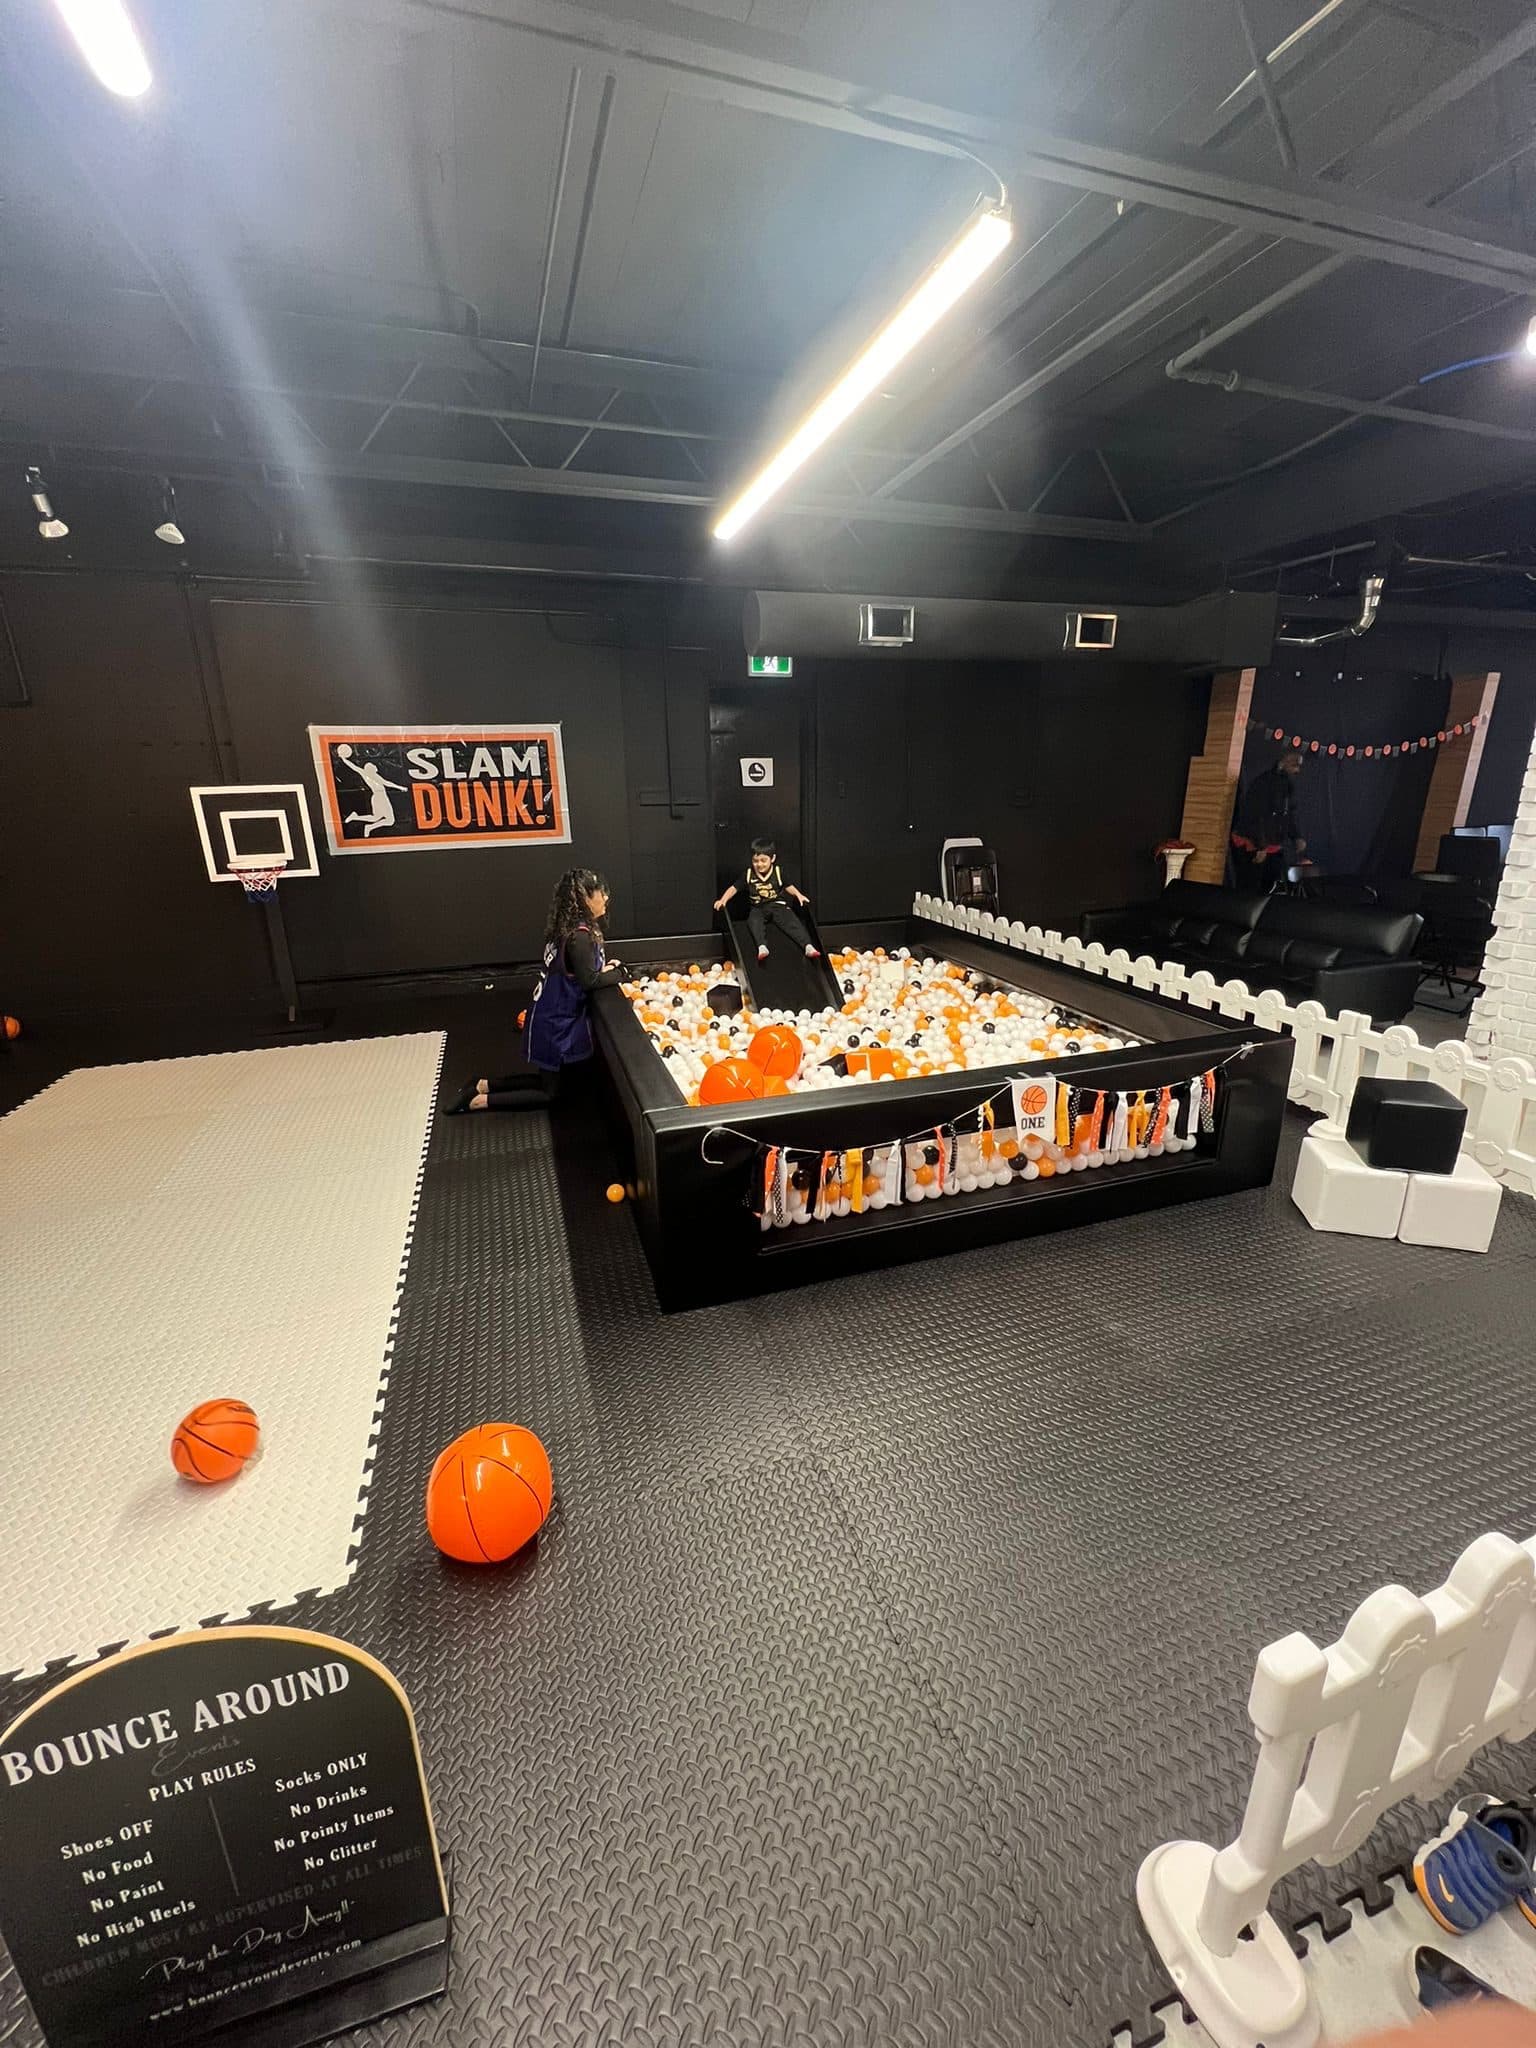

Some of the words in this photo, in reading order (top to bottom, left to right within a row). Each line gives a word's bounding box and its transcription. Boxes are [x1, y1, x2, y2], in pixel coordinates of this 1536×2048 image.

[406, 746, 542, 780] SLAM
[412, 779, 546, 830] DUNK!
[1021, 1117, 1045, 1130] ONE
[0, 1709, 179, 1786] BOUNCE
[193, 1661, 350, 1733] AROUND
[148, 1780, 195, 1801] PLAY
[201, 1758, 257, 1786] RULES
[275, 1770, 322, 1793] Socks
[327, 1753, 369, 1776] ONLY
[290, 1803, 311, 1818] No
[317, 1785, 367, 1809] Drinks
[60, 1834, 114, 1860] Shoes
[120, 1820, 154, 1842] OFF
[274, 1837, 295, 1853] No
[300, 1820, 348, 1845] Pointy
[354, 1805, 395, 1827] Items
[83, 1869, 106, 1885] No
[112, 1852, 153, 1876] Food
[304, 1856, 324, 1871] No
[330, 1839, 377, 1863] Glitter
[90, 1897, 115, 1913] No
[120, 1880, 165, 1904] Paint
[77, 1932, 100, 1948] No
[105, 1917, 145, 1940] High
[150, 1899, 196, 1923] Heels
[148, 1939, 362, 2021] wwwbouncearoundeventscom
